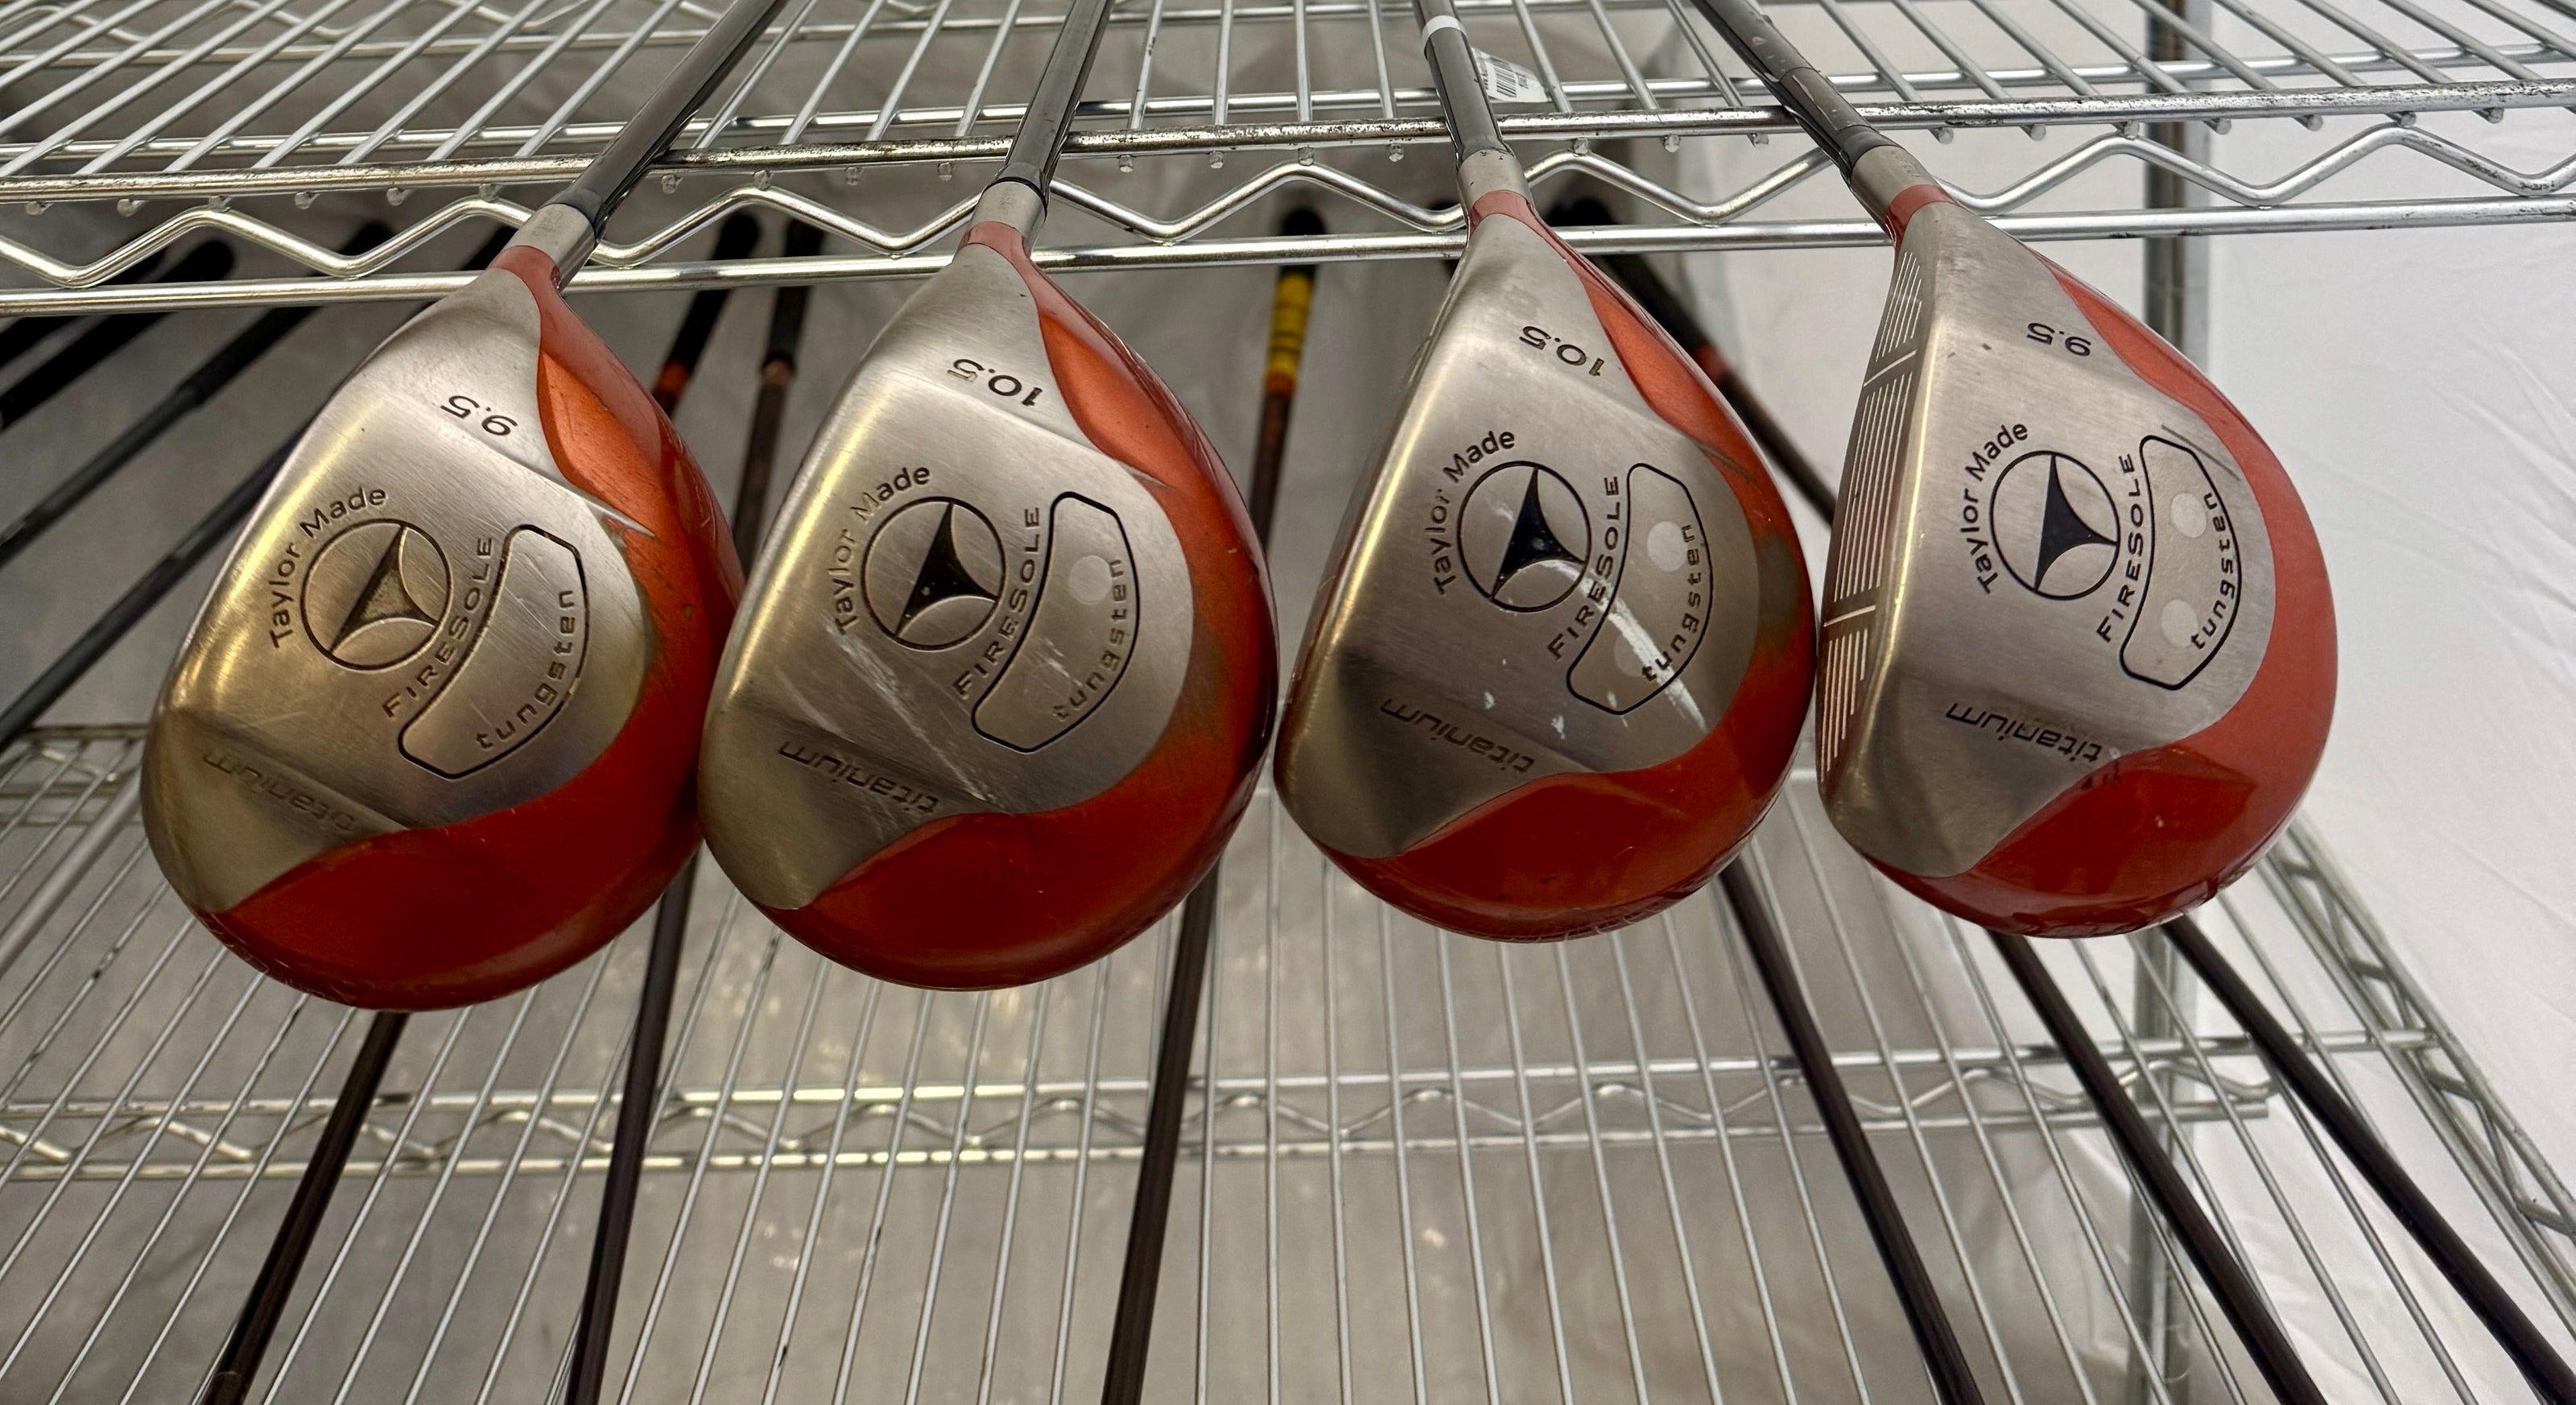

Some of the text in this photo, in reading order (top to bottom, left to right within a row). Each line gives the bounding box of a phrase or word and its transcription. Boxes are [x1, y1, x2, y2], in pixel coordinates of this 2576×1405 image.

[440, 395, 518, 436] 9.5
[947, 358, 1043, 407] 10.5
[1519, 324, 1604, 378] 10.5
[2027, 322, 2091, 357] 9.5
[269, 487, 387, 649] Taylor Made
[828, 465, 930, 635] Taylor Made
[1424, 429, 1515, 595] Taylor Made
[1546, 477, 1620, 660] FIRESOLE
[1959, 424, 2029, 595] Taylor Made
[2096, 454, 2144, 643] FIRESOLE
[2190, 491, 2235, 650] tungsten
[382, 537, 493, 717] FIRESOLE
[475, 589, 575, 750] tungsten
[952, 507, 1040, 700] FIRESOLE
[1052, 559, 1128, 722] tungsten
[1641, 524, 1701, 683] tungsten
[204, 753, 356, 832] titanium
[778, 739, 939, 815] titanium
[1380, 698, 1535, 774] titanium
[1946, 701, 2102, 763] titanium
